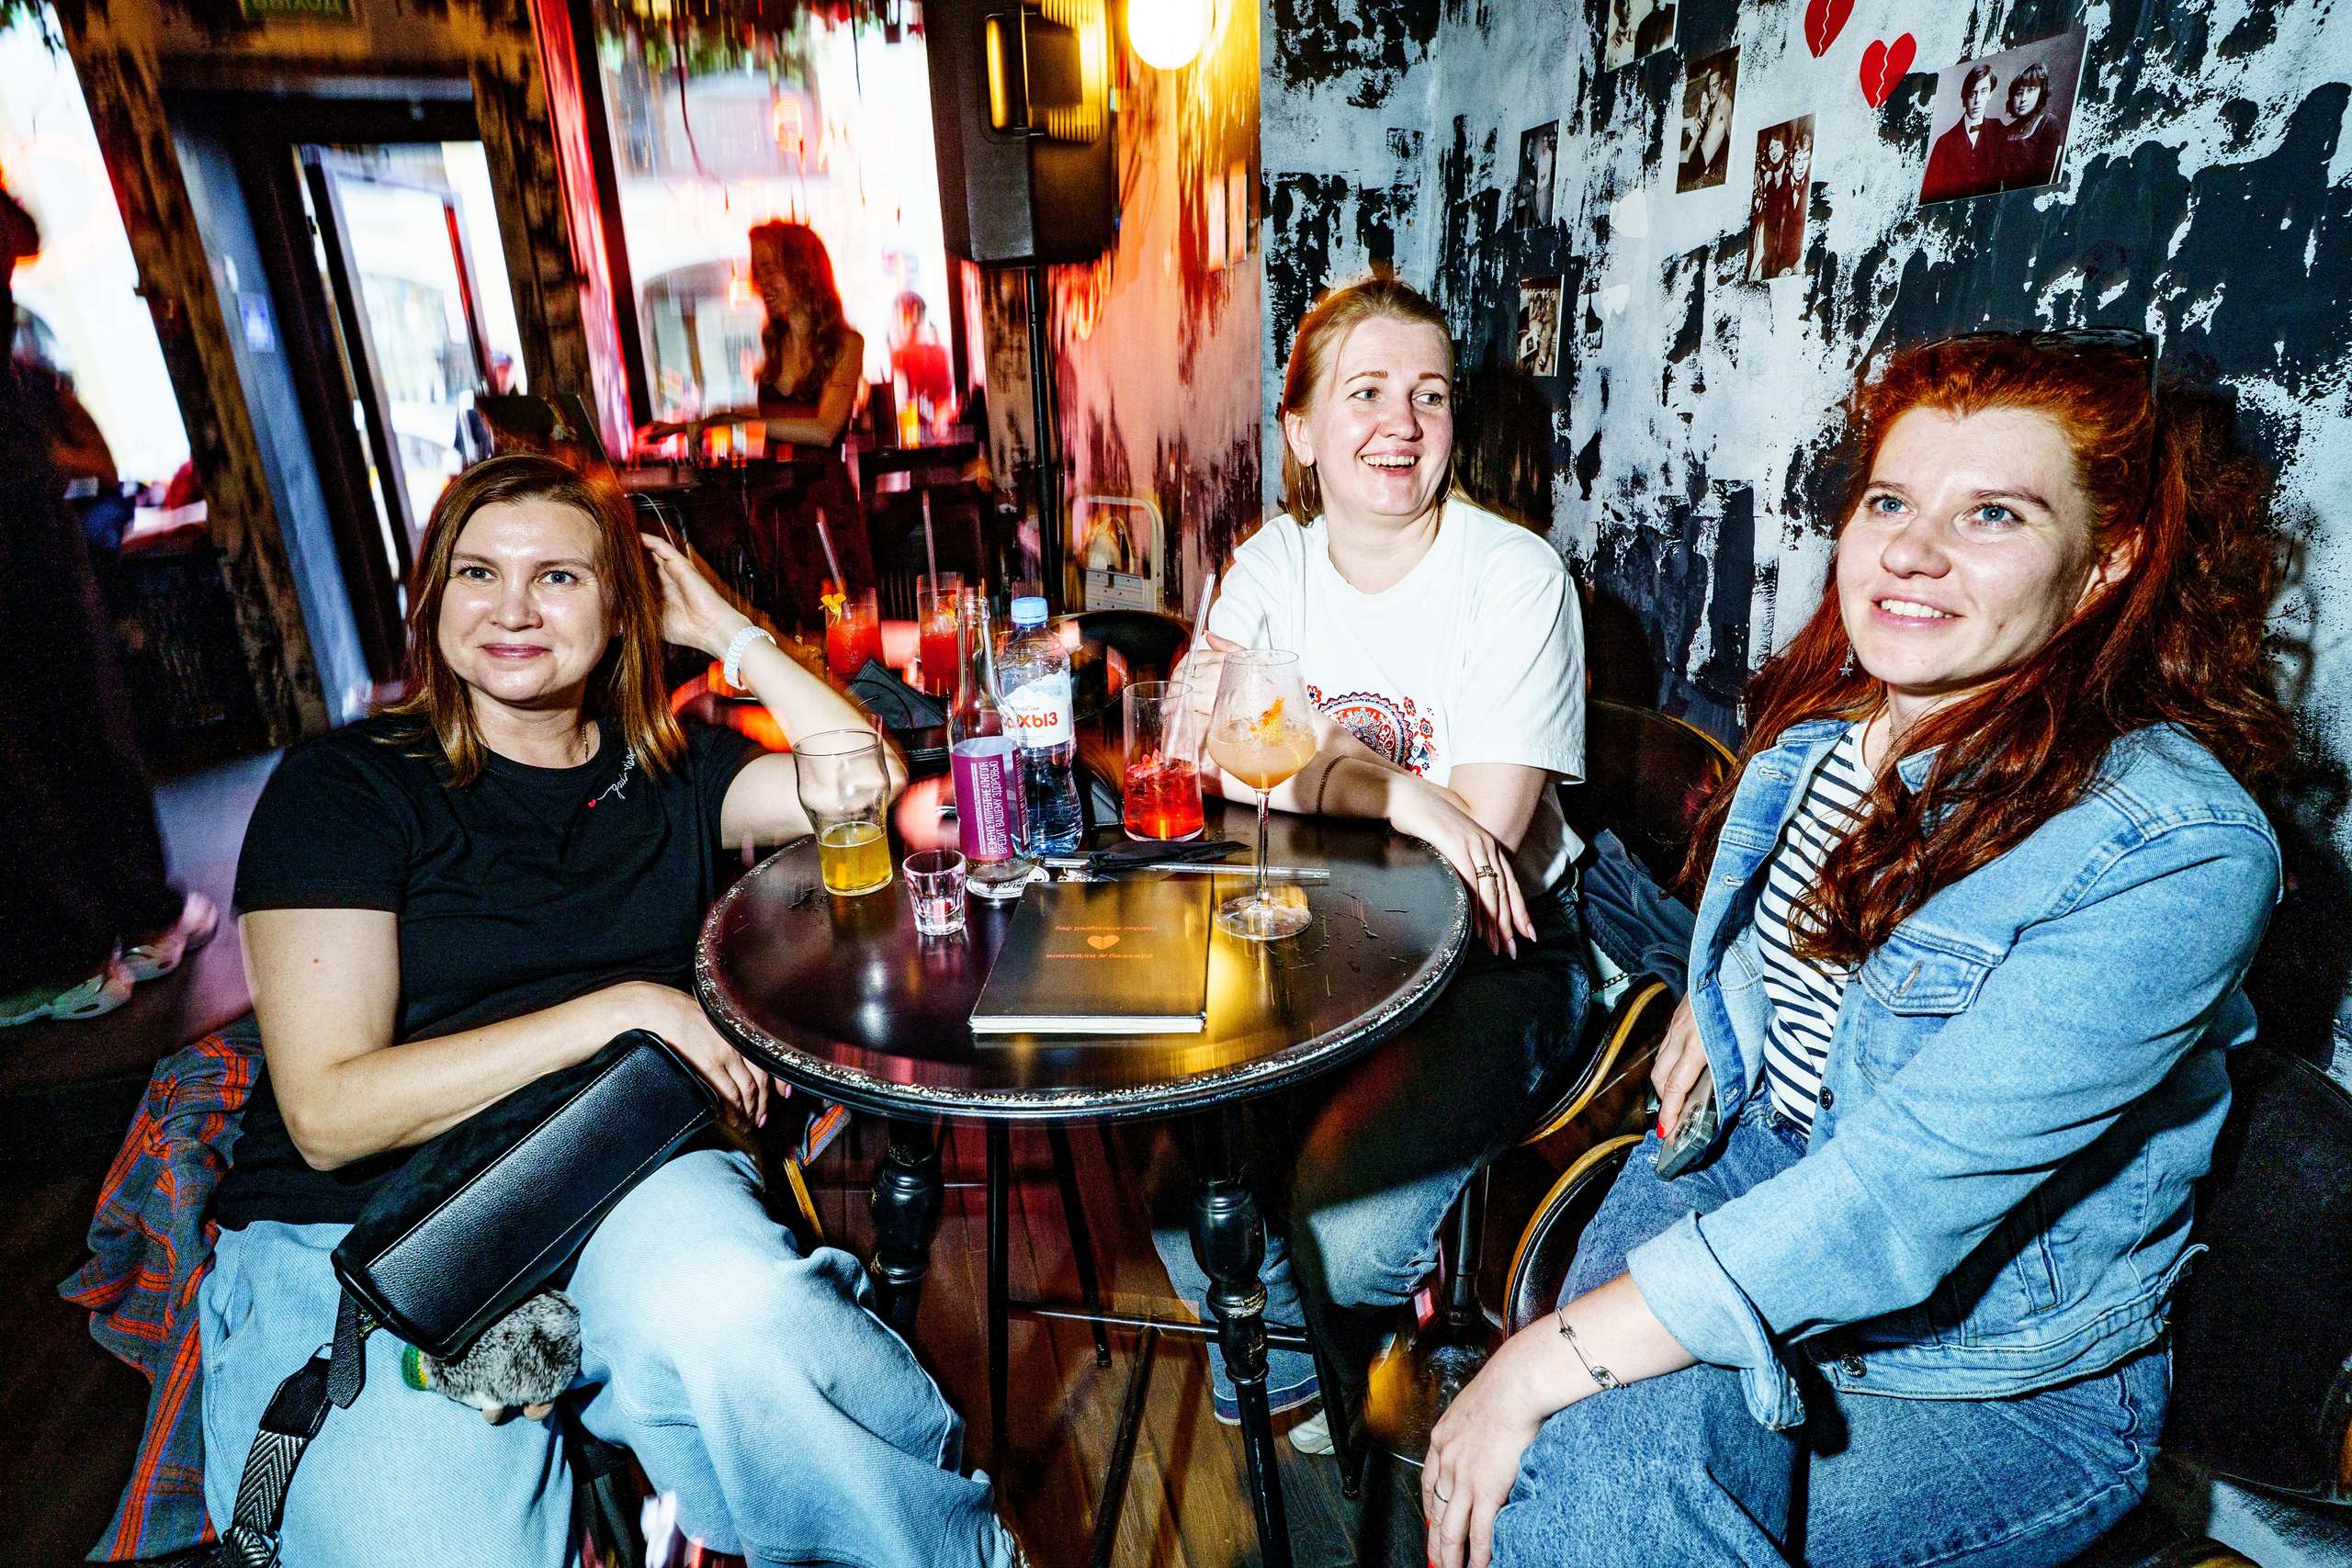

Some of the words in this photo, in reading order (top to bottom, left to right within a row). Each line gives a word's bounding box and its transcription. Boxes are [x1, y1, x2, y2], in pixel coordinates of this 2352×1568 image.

[989, 761, 1002, 797] ЗДОРОВЬЮ
[993, 799, 1005, 827] ВАШЕМУ
[996, 829, 1008, 854] ВРЕДИТ
